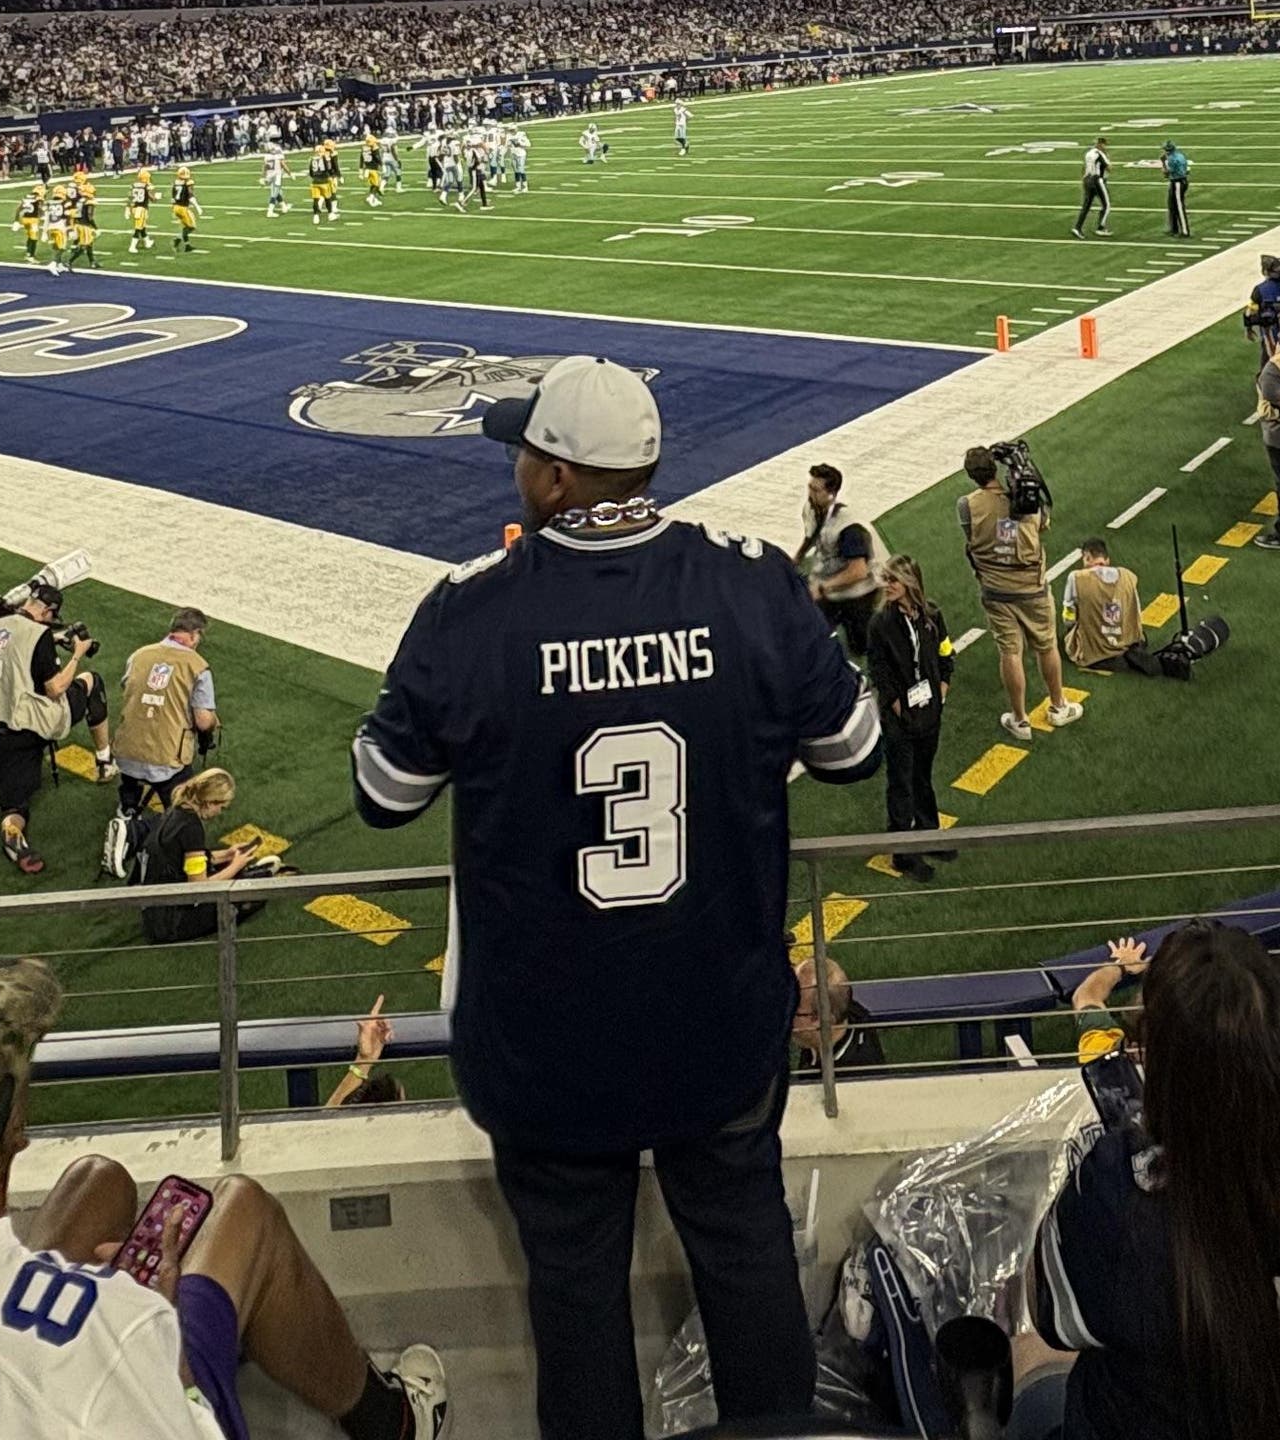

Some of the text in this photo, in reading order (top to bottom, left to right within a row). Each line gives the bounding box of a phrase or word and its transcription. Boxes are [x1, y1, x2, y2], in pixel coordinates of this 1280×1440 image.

[540, 626, 715, 696] PICKENS
[574, 720, 688, 910] 3
[0, 1258, 98, 1348] 8
